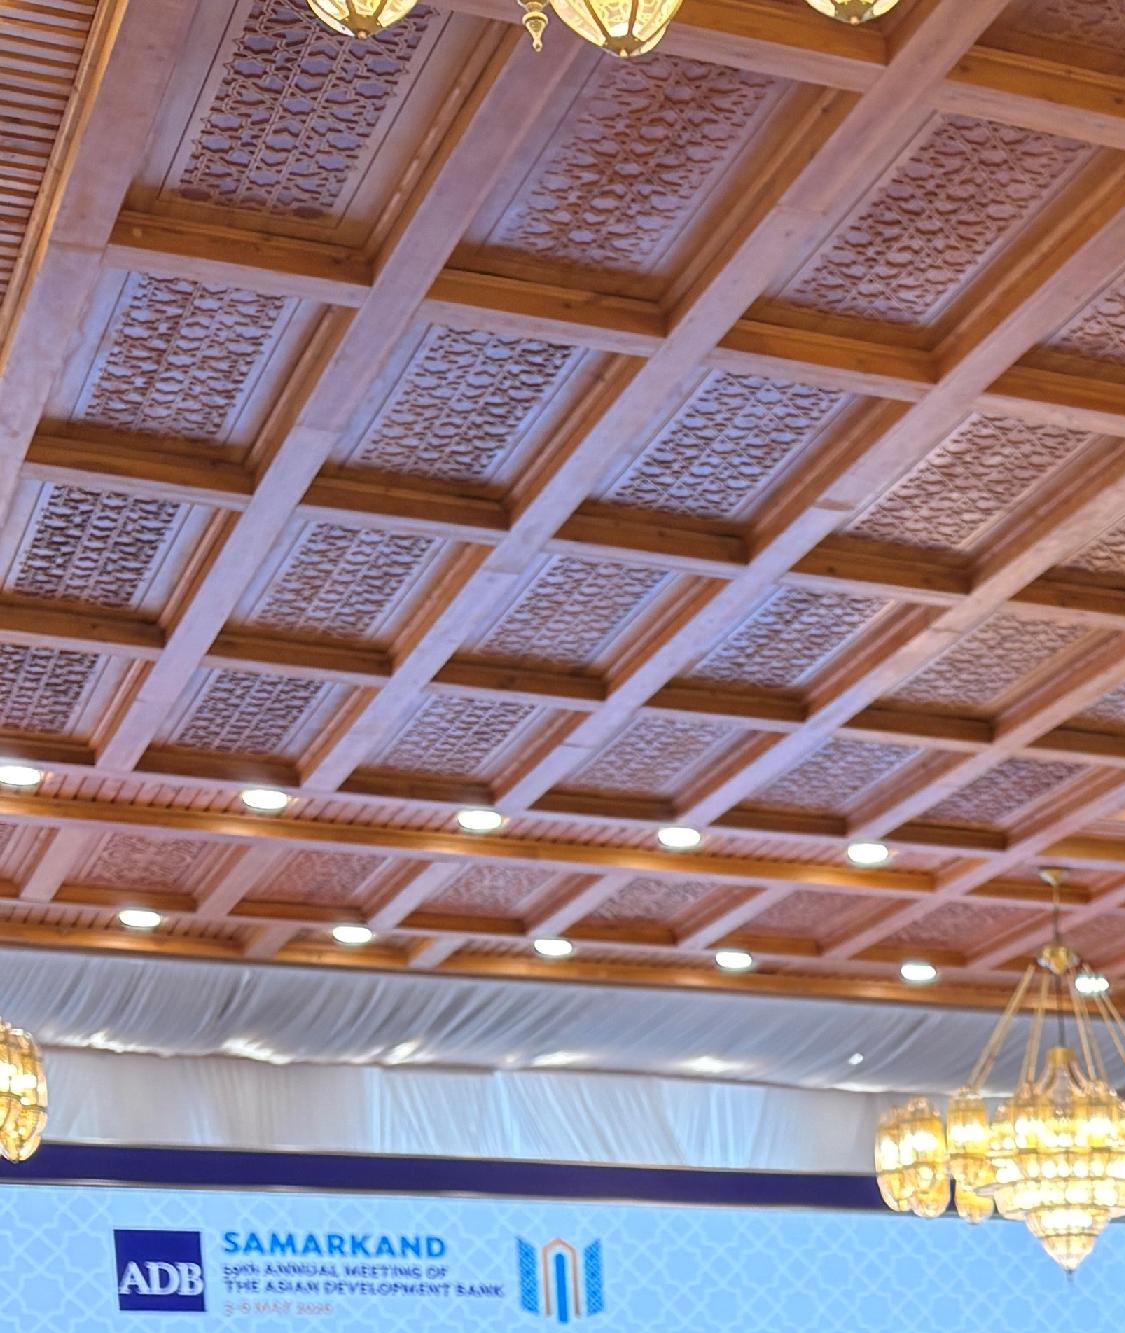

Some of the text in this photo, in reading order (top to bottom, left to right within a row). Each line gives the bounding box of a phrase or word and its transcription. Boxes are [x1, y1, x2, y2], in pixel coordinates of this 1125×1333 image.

[223, 1231, 446, 1258] SAMARKAND
[118, 1260, 204, 1296] ADB
[264, 1262, 339, 1277] ANNUAL
[344, 1264, 422, 1279] MEETING
[426, 1265, 448, 1279] OF
[223, 1279, 505, 1298] THE ASIAN DEVELOPMENT BANK
